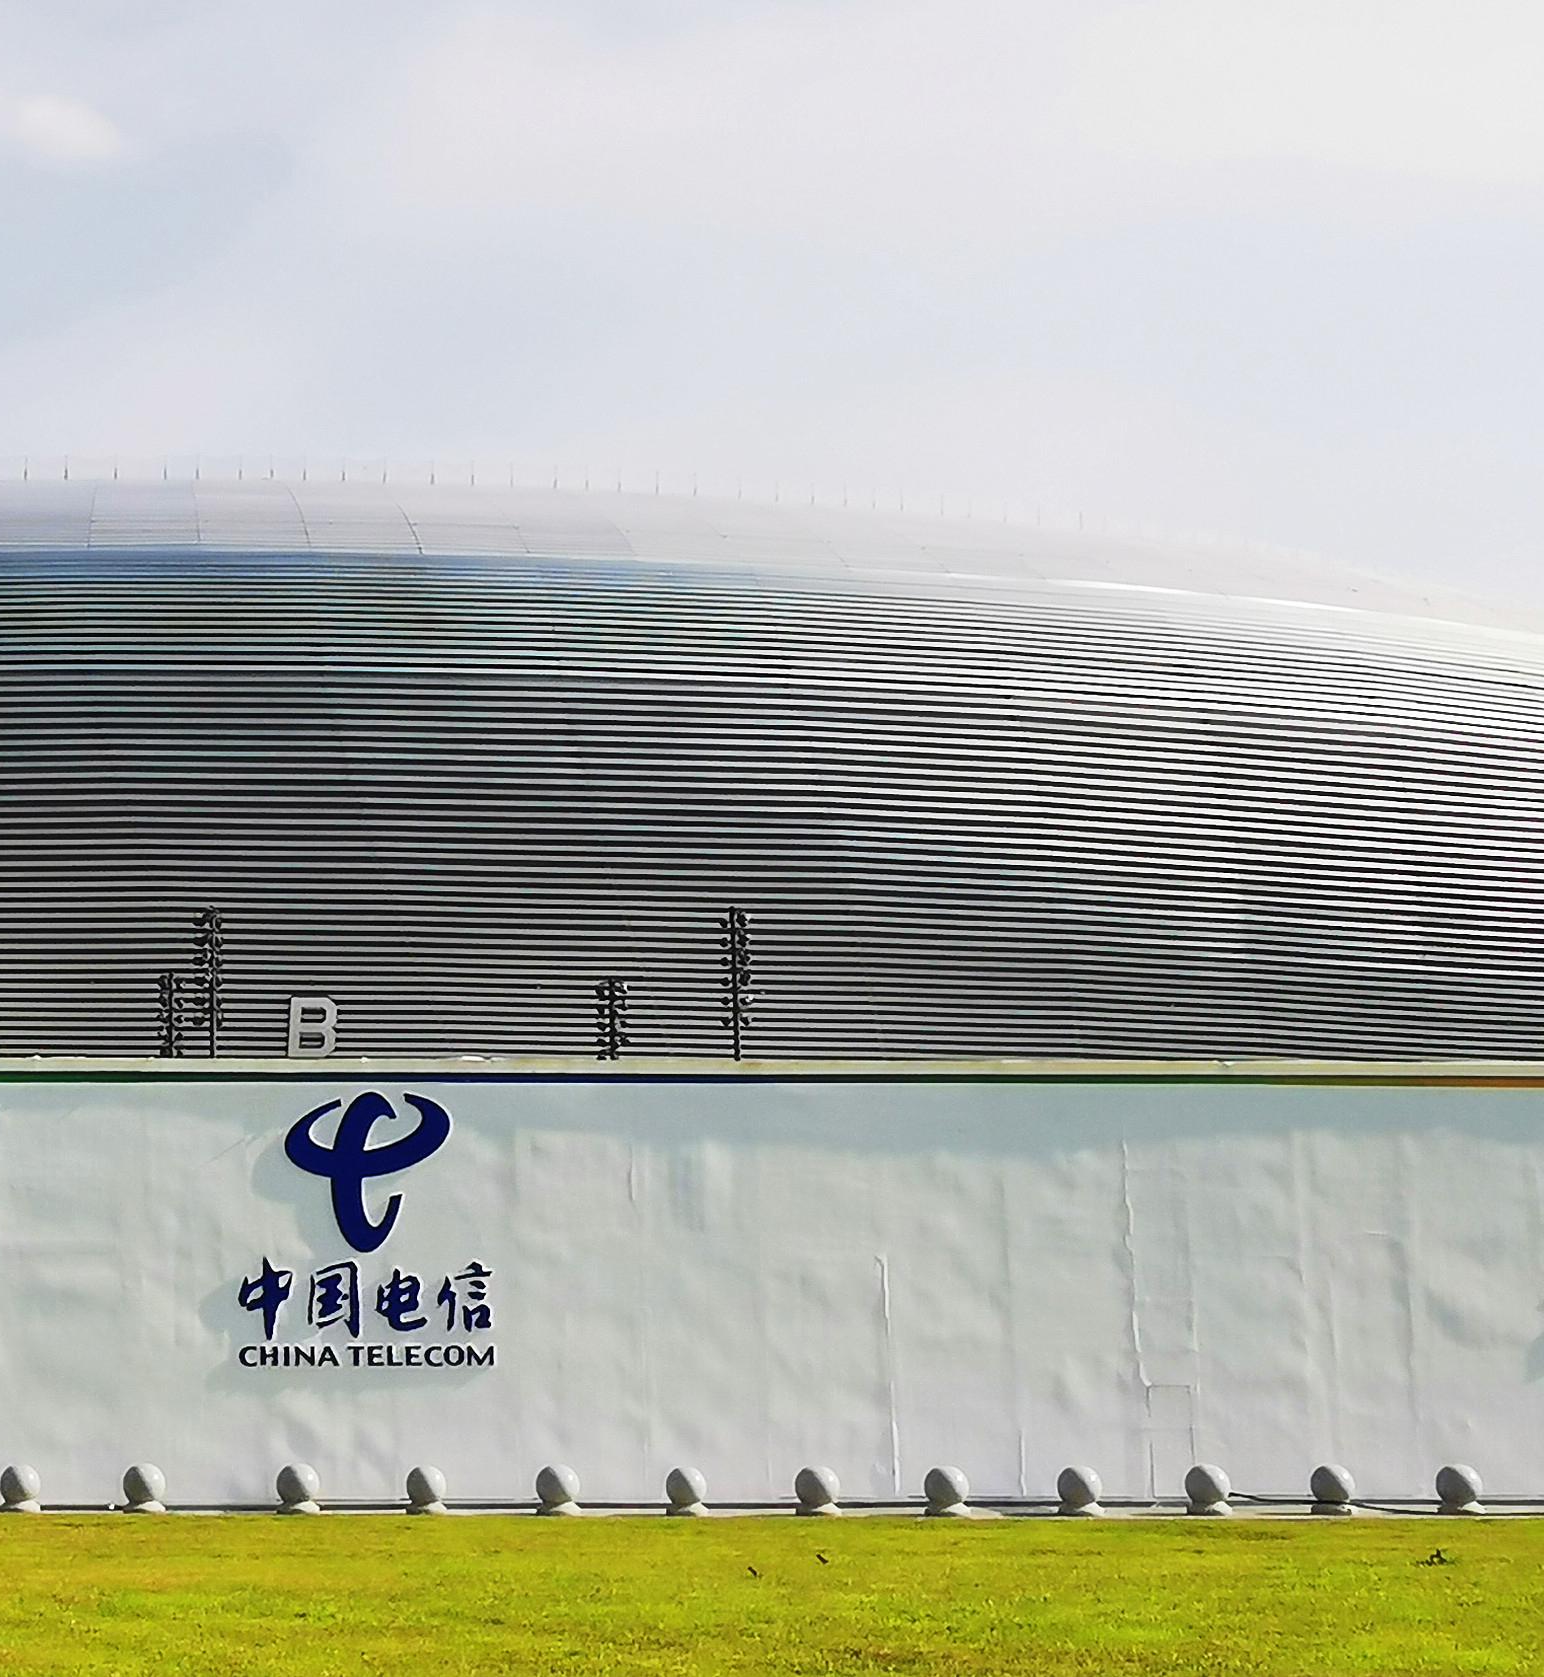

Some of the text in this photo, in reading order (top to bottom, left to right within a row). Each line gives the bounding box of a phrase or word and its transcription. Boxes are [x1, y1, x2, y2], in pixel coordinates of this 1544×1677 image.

[288, 997, 337, 1057] B
[238, 1256, 493, 1341] 中国电信
[238, 1346, 495, 1367] CHINA TELECOM
